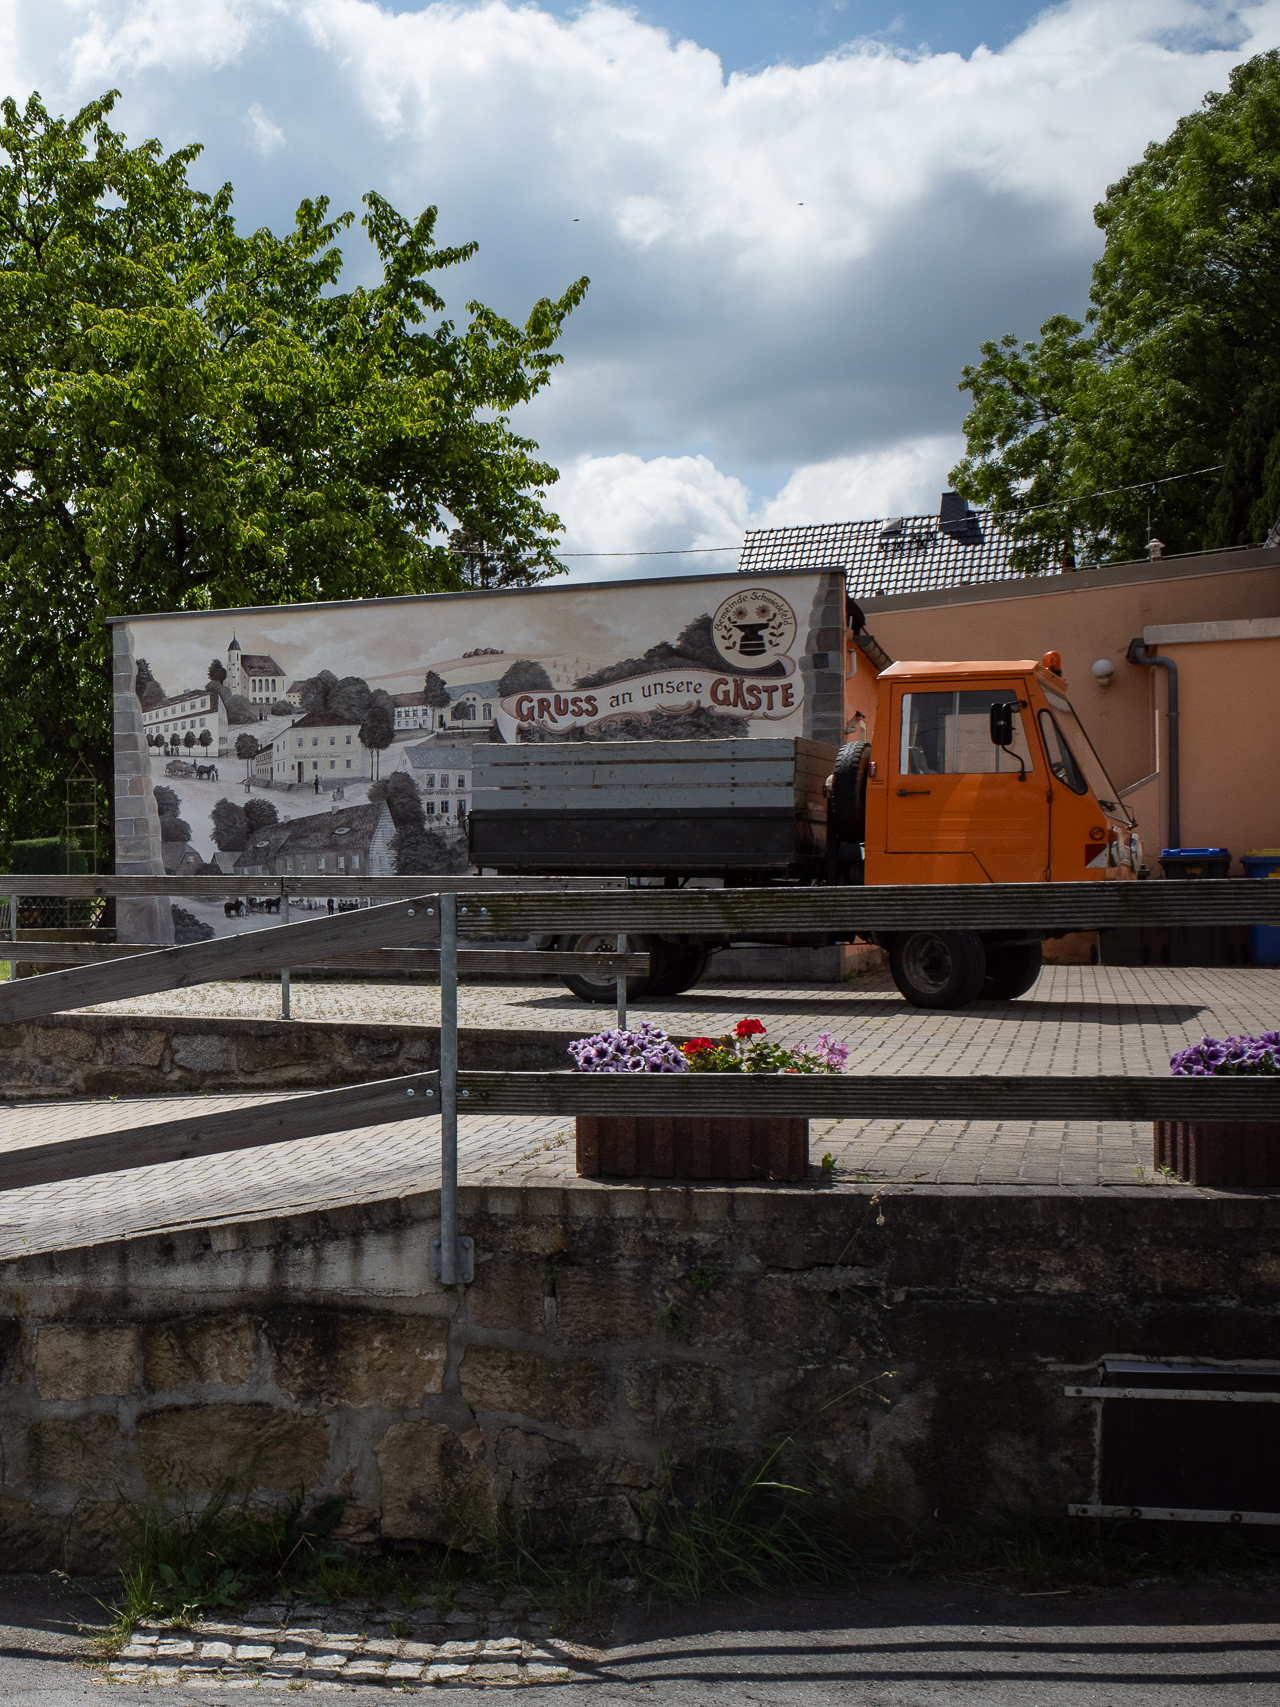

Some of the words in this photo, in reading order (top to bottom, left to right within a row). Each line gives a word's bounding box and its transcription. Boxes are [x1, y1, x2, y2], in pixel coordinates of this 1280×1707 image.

[714, 595, 748, 631] Gemeinde
[750, 592, 793, 626] Schmiedefeld
[515, 694, 599, 723] GRUSS
[609, 691, 633, 708] an
[641, 680, 703, 698] unsere
[710, 677, 795, 711] GÄSTE
